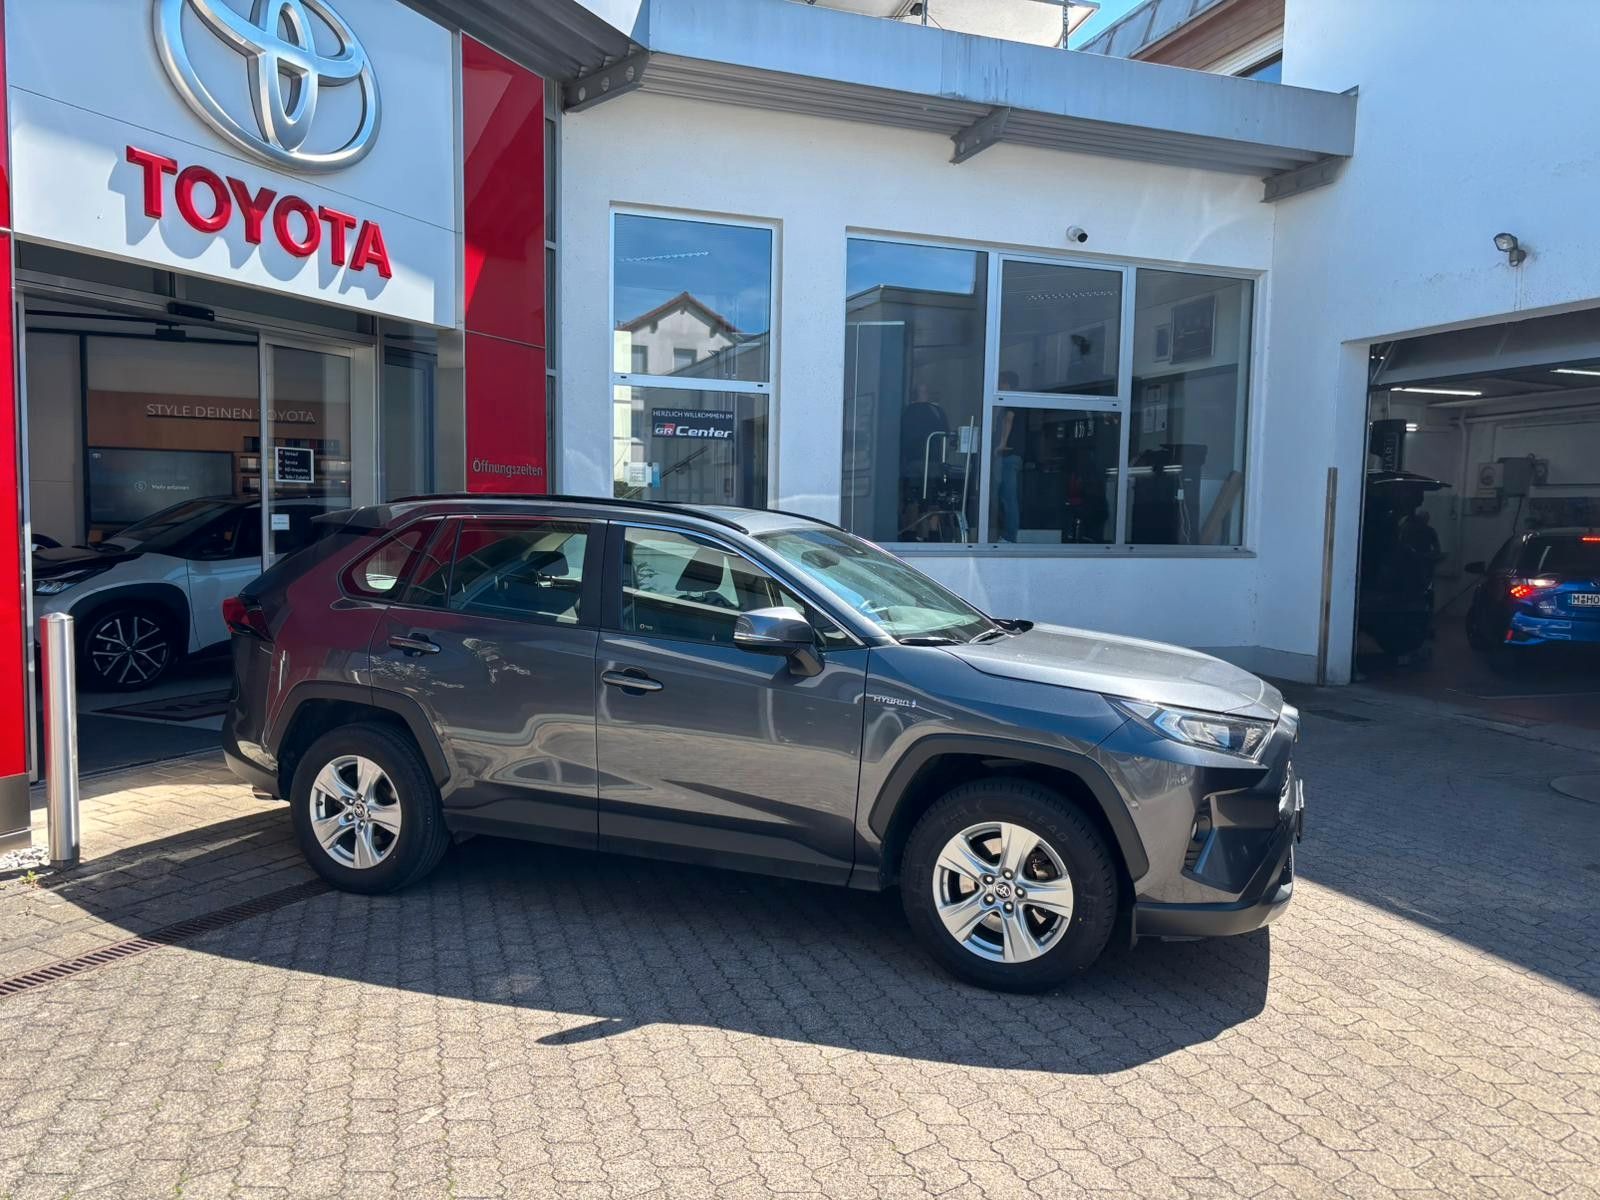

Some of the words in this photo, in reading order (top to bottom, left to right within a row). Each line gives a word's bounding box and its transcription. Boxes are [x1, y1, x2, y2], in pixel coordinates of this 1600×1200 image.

[126, 145, 392, 280] TOYOTA
[146, 403, 191, 416] STYLE
[195, 406, 253, 419] DEINEN
[259, 409, 316, 422] OYOTA
[652, 409, 683, 417] HERZLICH
[683, 411, 724, 419] WILLKOMMEN
[675, 425, 732, 438] Center
[472, 457, 543, 478] Öffnungszeiten
[873, 695, 910, 707] HYBRID
